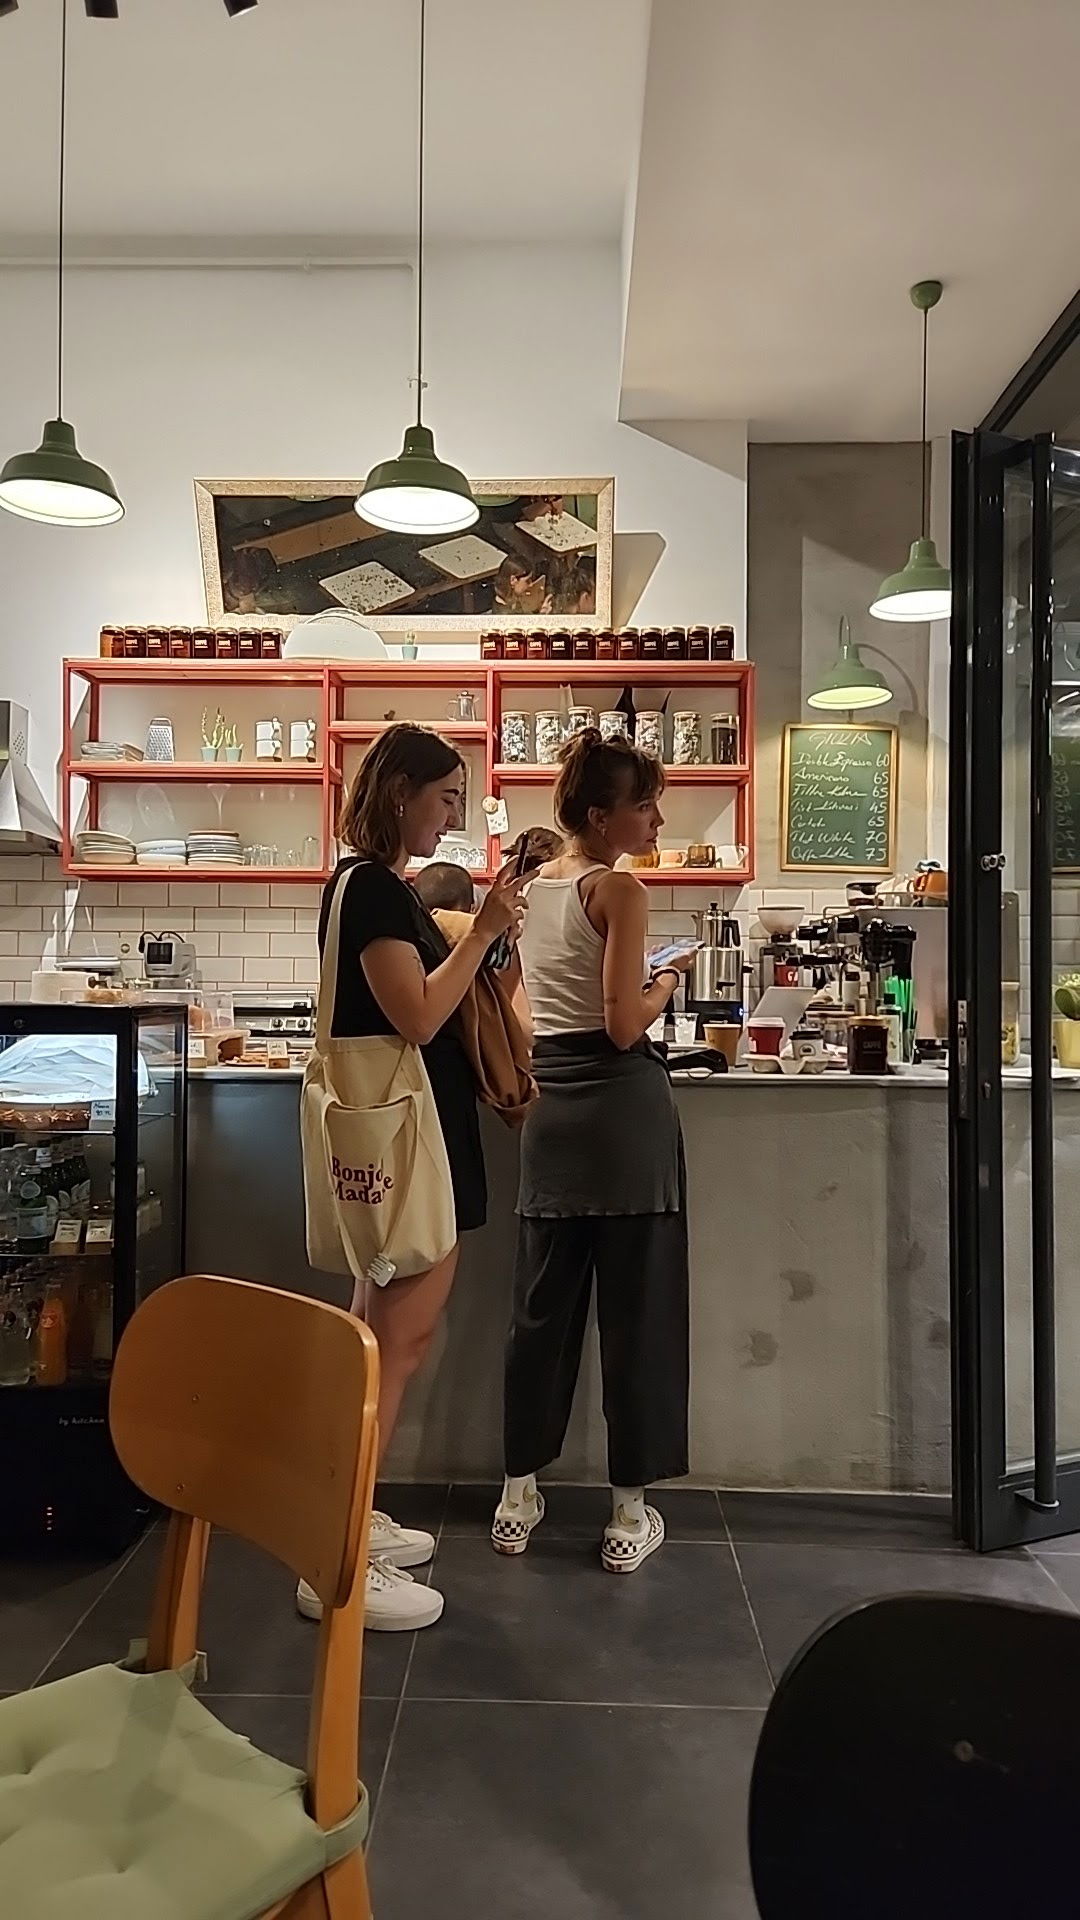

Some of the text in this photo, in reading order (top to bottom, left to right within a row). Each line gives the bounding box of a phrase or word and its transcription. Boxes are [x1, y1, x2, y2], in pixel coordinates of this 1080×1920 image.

[876, 753, 890, 767] 60
[792, 767, 889, 785] Americano 65
[872, 785, 889, 799] 65
[869, 801, 888, 814] 45
[867, 816, 885, 828] 65
[865, 831, 887, 845] 70
[865, 847, 887, 861] 75
